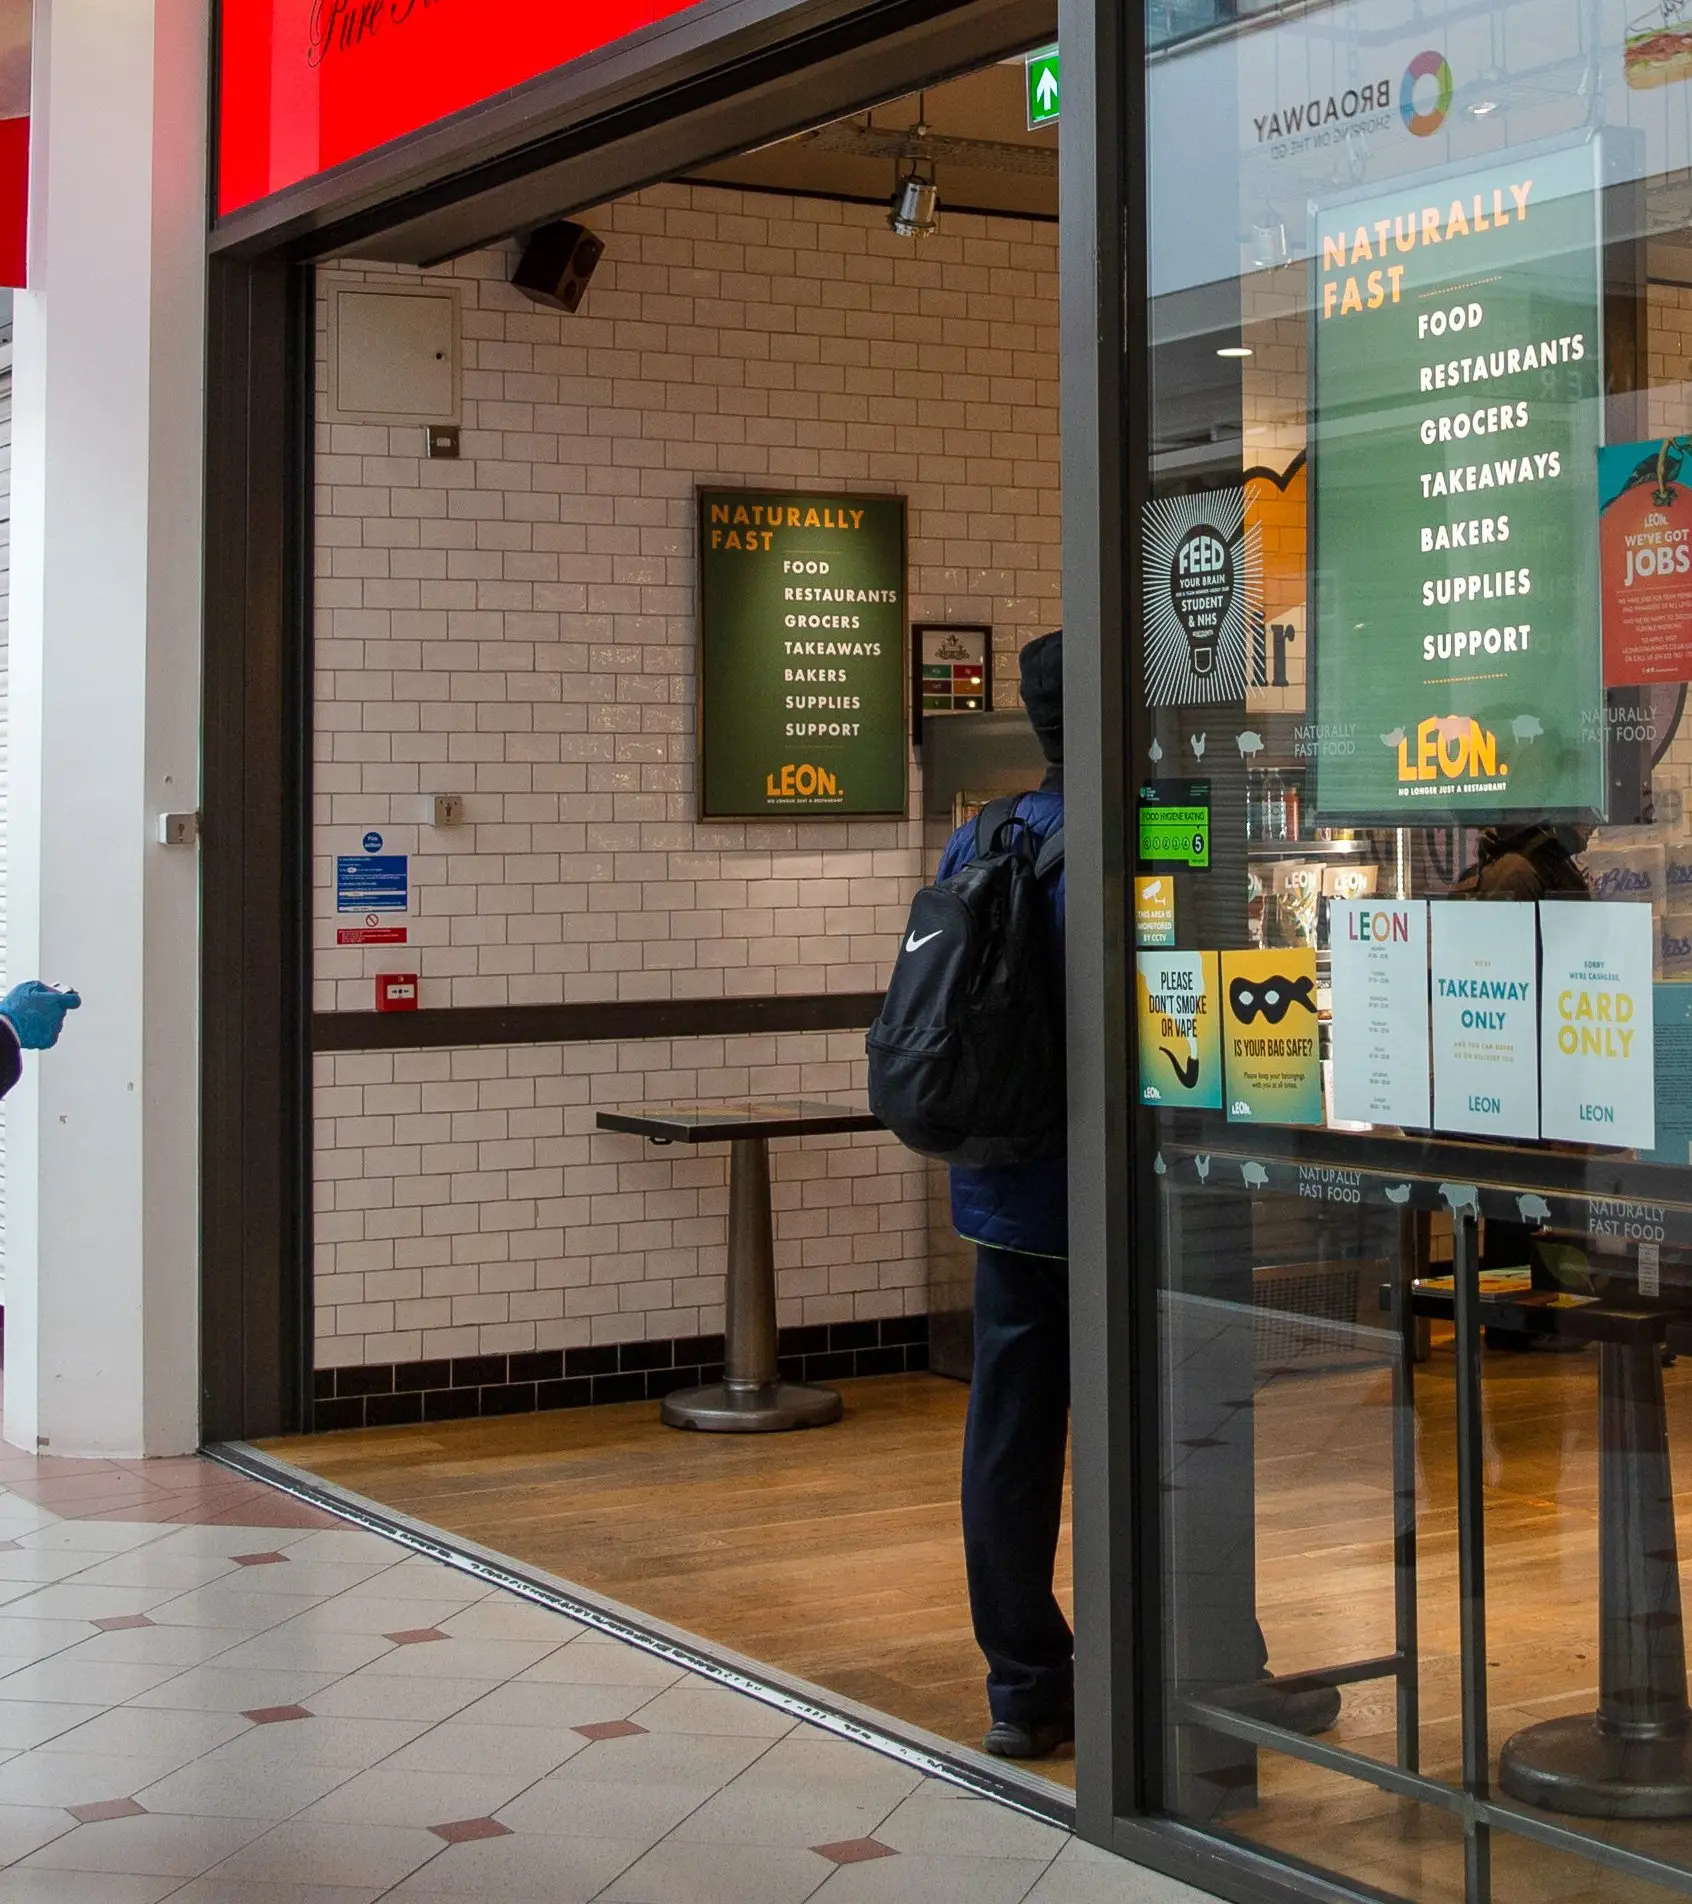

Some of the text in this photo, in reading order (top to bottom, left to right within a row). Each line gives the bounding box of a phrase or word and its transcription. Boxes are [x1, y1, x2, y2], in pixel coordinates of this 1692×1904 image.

[1323, 180, 1533, 272] NATURALLY
[1323, 265, 1404, 319] FAST
[1418, 303, 1483, 339] FOOD
[1420, 334, 1585, 392] RESTAURANTS
[1421, 402, 1529, 445] GROCERS
[1421, 451, 1561, 499] TAKEAWAYS
[711, 504, 865, 529] NATURALLY
[711, 530, 773, 551] FAST
[1421, 516, 1510, 552] BAKERS
[1625, 529, 1690, 547] WE'VE GOT
[1179, 535, 1225, 575] FEED
[783, 561, 829, 575] FOOD
[1624, 544, 1691, 587] JOBS
[1179, 574, 1226, 589] YOUR BRAIN
[1423, 568, 1531, 606] SUPPLIES
[784, 588, 897, 603] RESTAURANTS
[1181, 595, 1224, 612] STUDENT
[784, 615, 860, 629] GROCERS
[1188, 612, 1217, 628] & NHS
[784, 642, 881, 656] TAKEAWAYS
[1423, 625, 1531, 661] SUPPORT
[784, 669, 847, 682] BAKERS
[785, 696, 860, 710] SUPPLIES
[1581, 706, 1658, 726] NATURALLY
[785, 723, 860, 736] SUPPORT
[1294, 723, 1356, 740] NATURALLY
[1582, 725, 1657, 743] FAST FOOD
[1294, 741, 1356, 758] FAST FOOD
[1411, 786, 1438, 796] LONGER
[1439, 784, 1455, 794] JUST
[1464, 782, 1507, 792] RESTAURANT
[1184, 811, 1204, 821] RATING
[1194, 836, 1202, 852] 5
[1150, 910, 1165, 918] AREA
[1138, 922, 1172, 931] MONITORED
[1349, 911, 1408, 942] LEON
[1143, 933, 1167, 942] BY CCTV
[1584, 960, 1605, 969] SORRY
[1160, 971, 1193, 991] PLEASE
[1437, 978, 1529, 1001] TAKEAWAY
[1149, 994, 1207, 1014] DON'T SMOKE
[1558, 990, 1634, 1023] CARD
[1161, 1018, 1198, 1038] OR VAPE
[1461, 1009, 1506, 1030] ONLY
[1234, 1038, 1313, 1057] IS YOUR BAG SAFE?
[1558, 1025, 1636, 1058] ONLY
[1468, 1095, 1501, 1114] LEON
[1579, 1104, 1614, 1123] LEON
[1299, 1165, 1362, 1187] NATURALLY
[1299, 1183, 1361, 1204] FAST FOOD
[1588, 1200, 1665, 1224] NATURALLY
[1588, 1217, 1665, 1242] FAST FOOD
